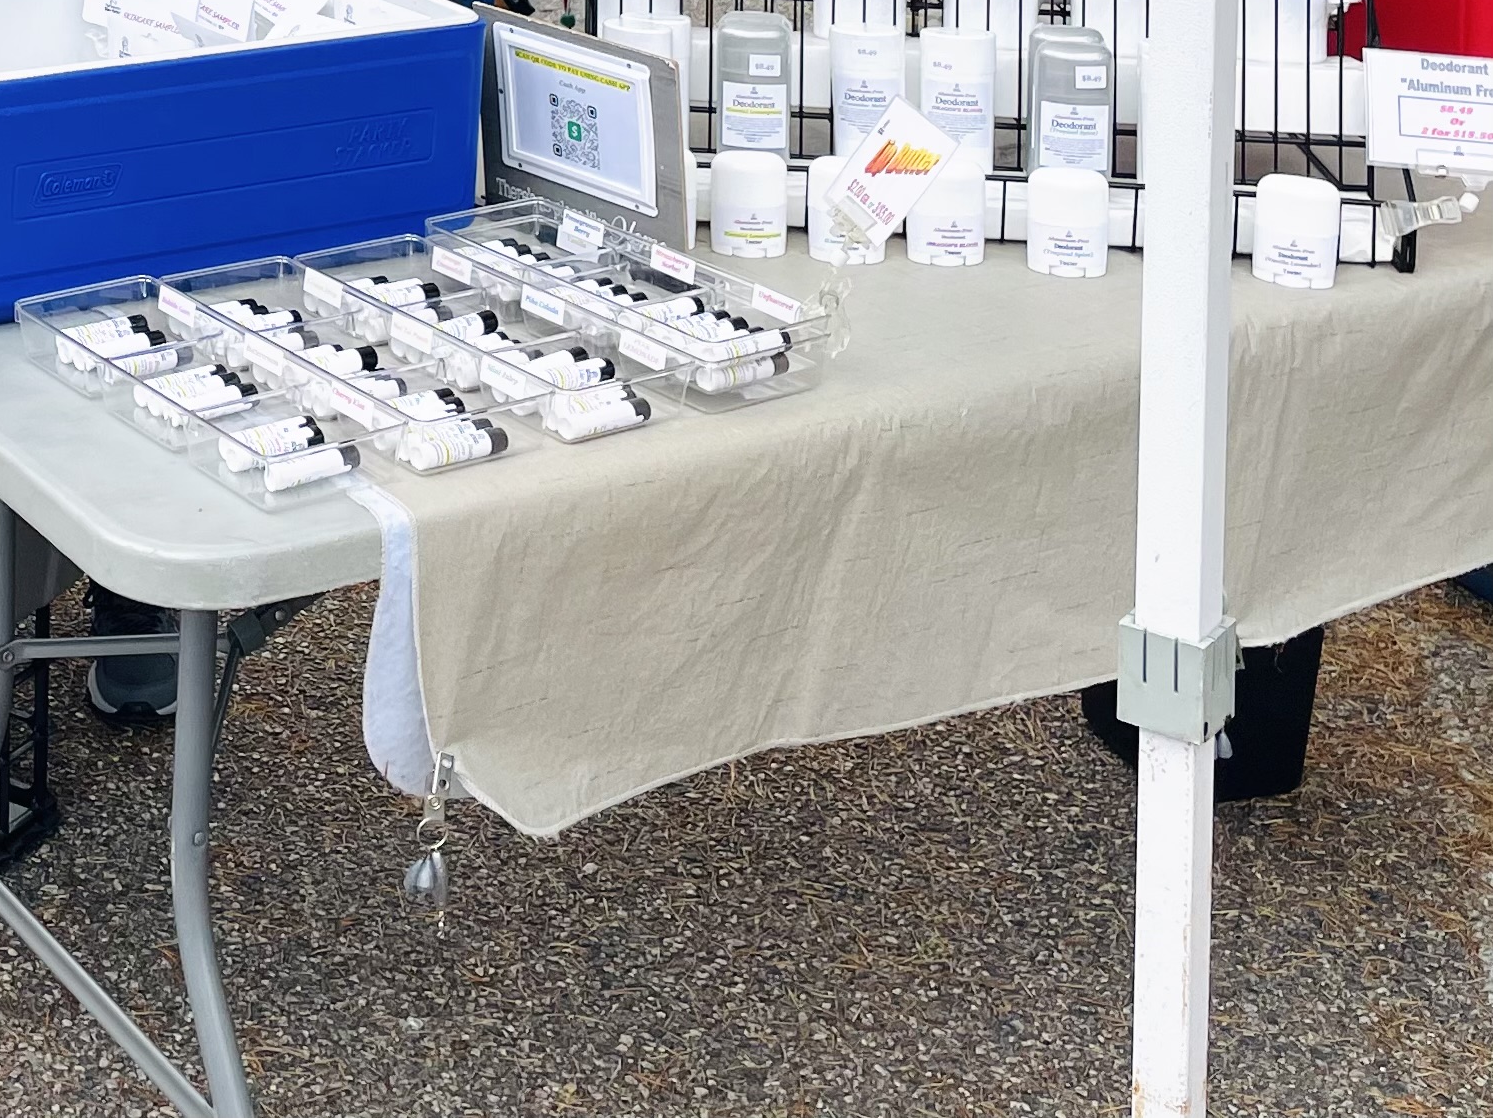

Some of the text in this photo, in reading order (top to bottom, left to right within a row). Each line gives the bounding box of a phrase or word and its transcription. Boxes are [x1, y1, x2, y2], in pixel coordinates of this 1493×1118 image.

[933, 61, 952, 71] $8.49
[1421, 58, 1489, 76] Deodorant
[559, 80, 586, 94] Cash App
[1401, 77, 1472, 96] "Aluminum
[844, 92, 886, 103] Deodorant
[935, 96, 979, 107] Deodorant
[732, 98, 775, 109] Deodorant
[1440, 105, 1473, 114] $8.49
[1052, 119, 1096, 130] Deodorant
[1450, 118, 1465, 126] Or
[1421, 127, 1429, 135] 2
[1432, 128, 1451, 137] for
[885, 142, 942, 176] Butter
[42, 172, 102, 199] Coleman
